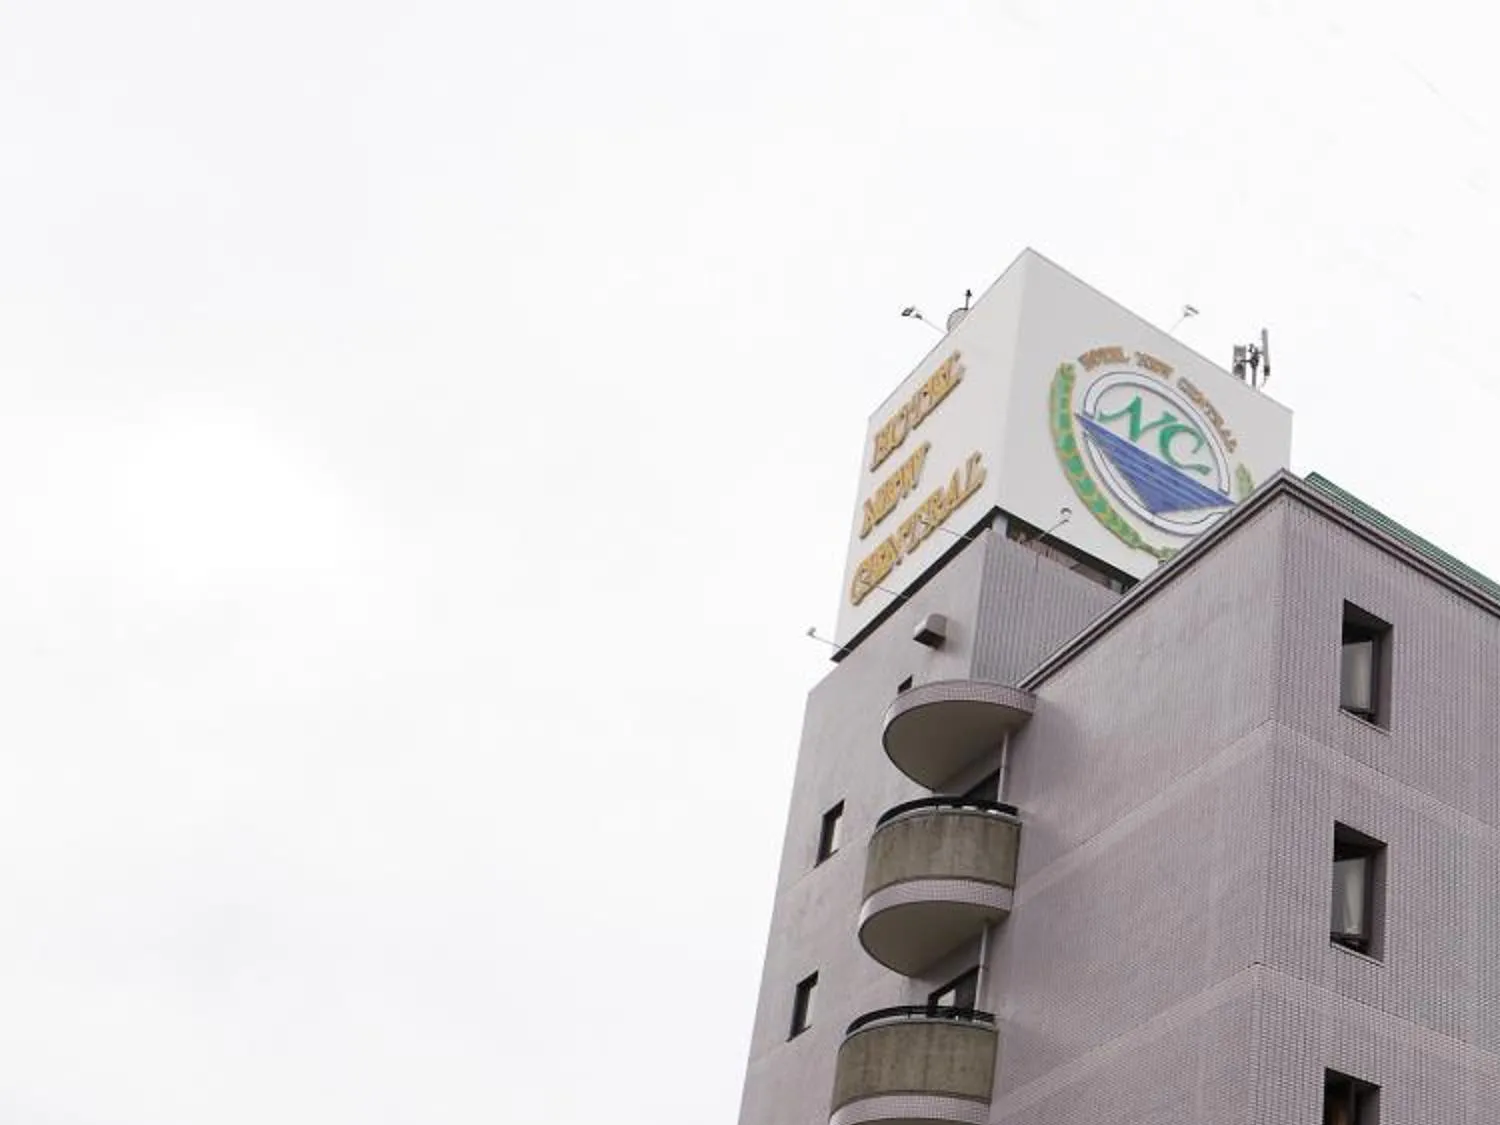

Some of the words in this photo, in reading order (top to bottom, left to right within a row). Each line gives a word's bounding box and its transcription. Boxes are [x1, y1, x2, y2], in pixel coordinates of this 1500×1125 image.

[870, 349, 966, 473] HOTEL
[1097, 394, 1213, 477] NC
[859, 440, 931, 540] NEW
